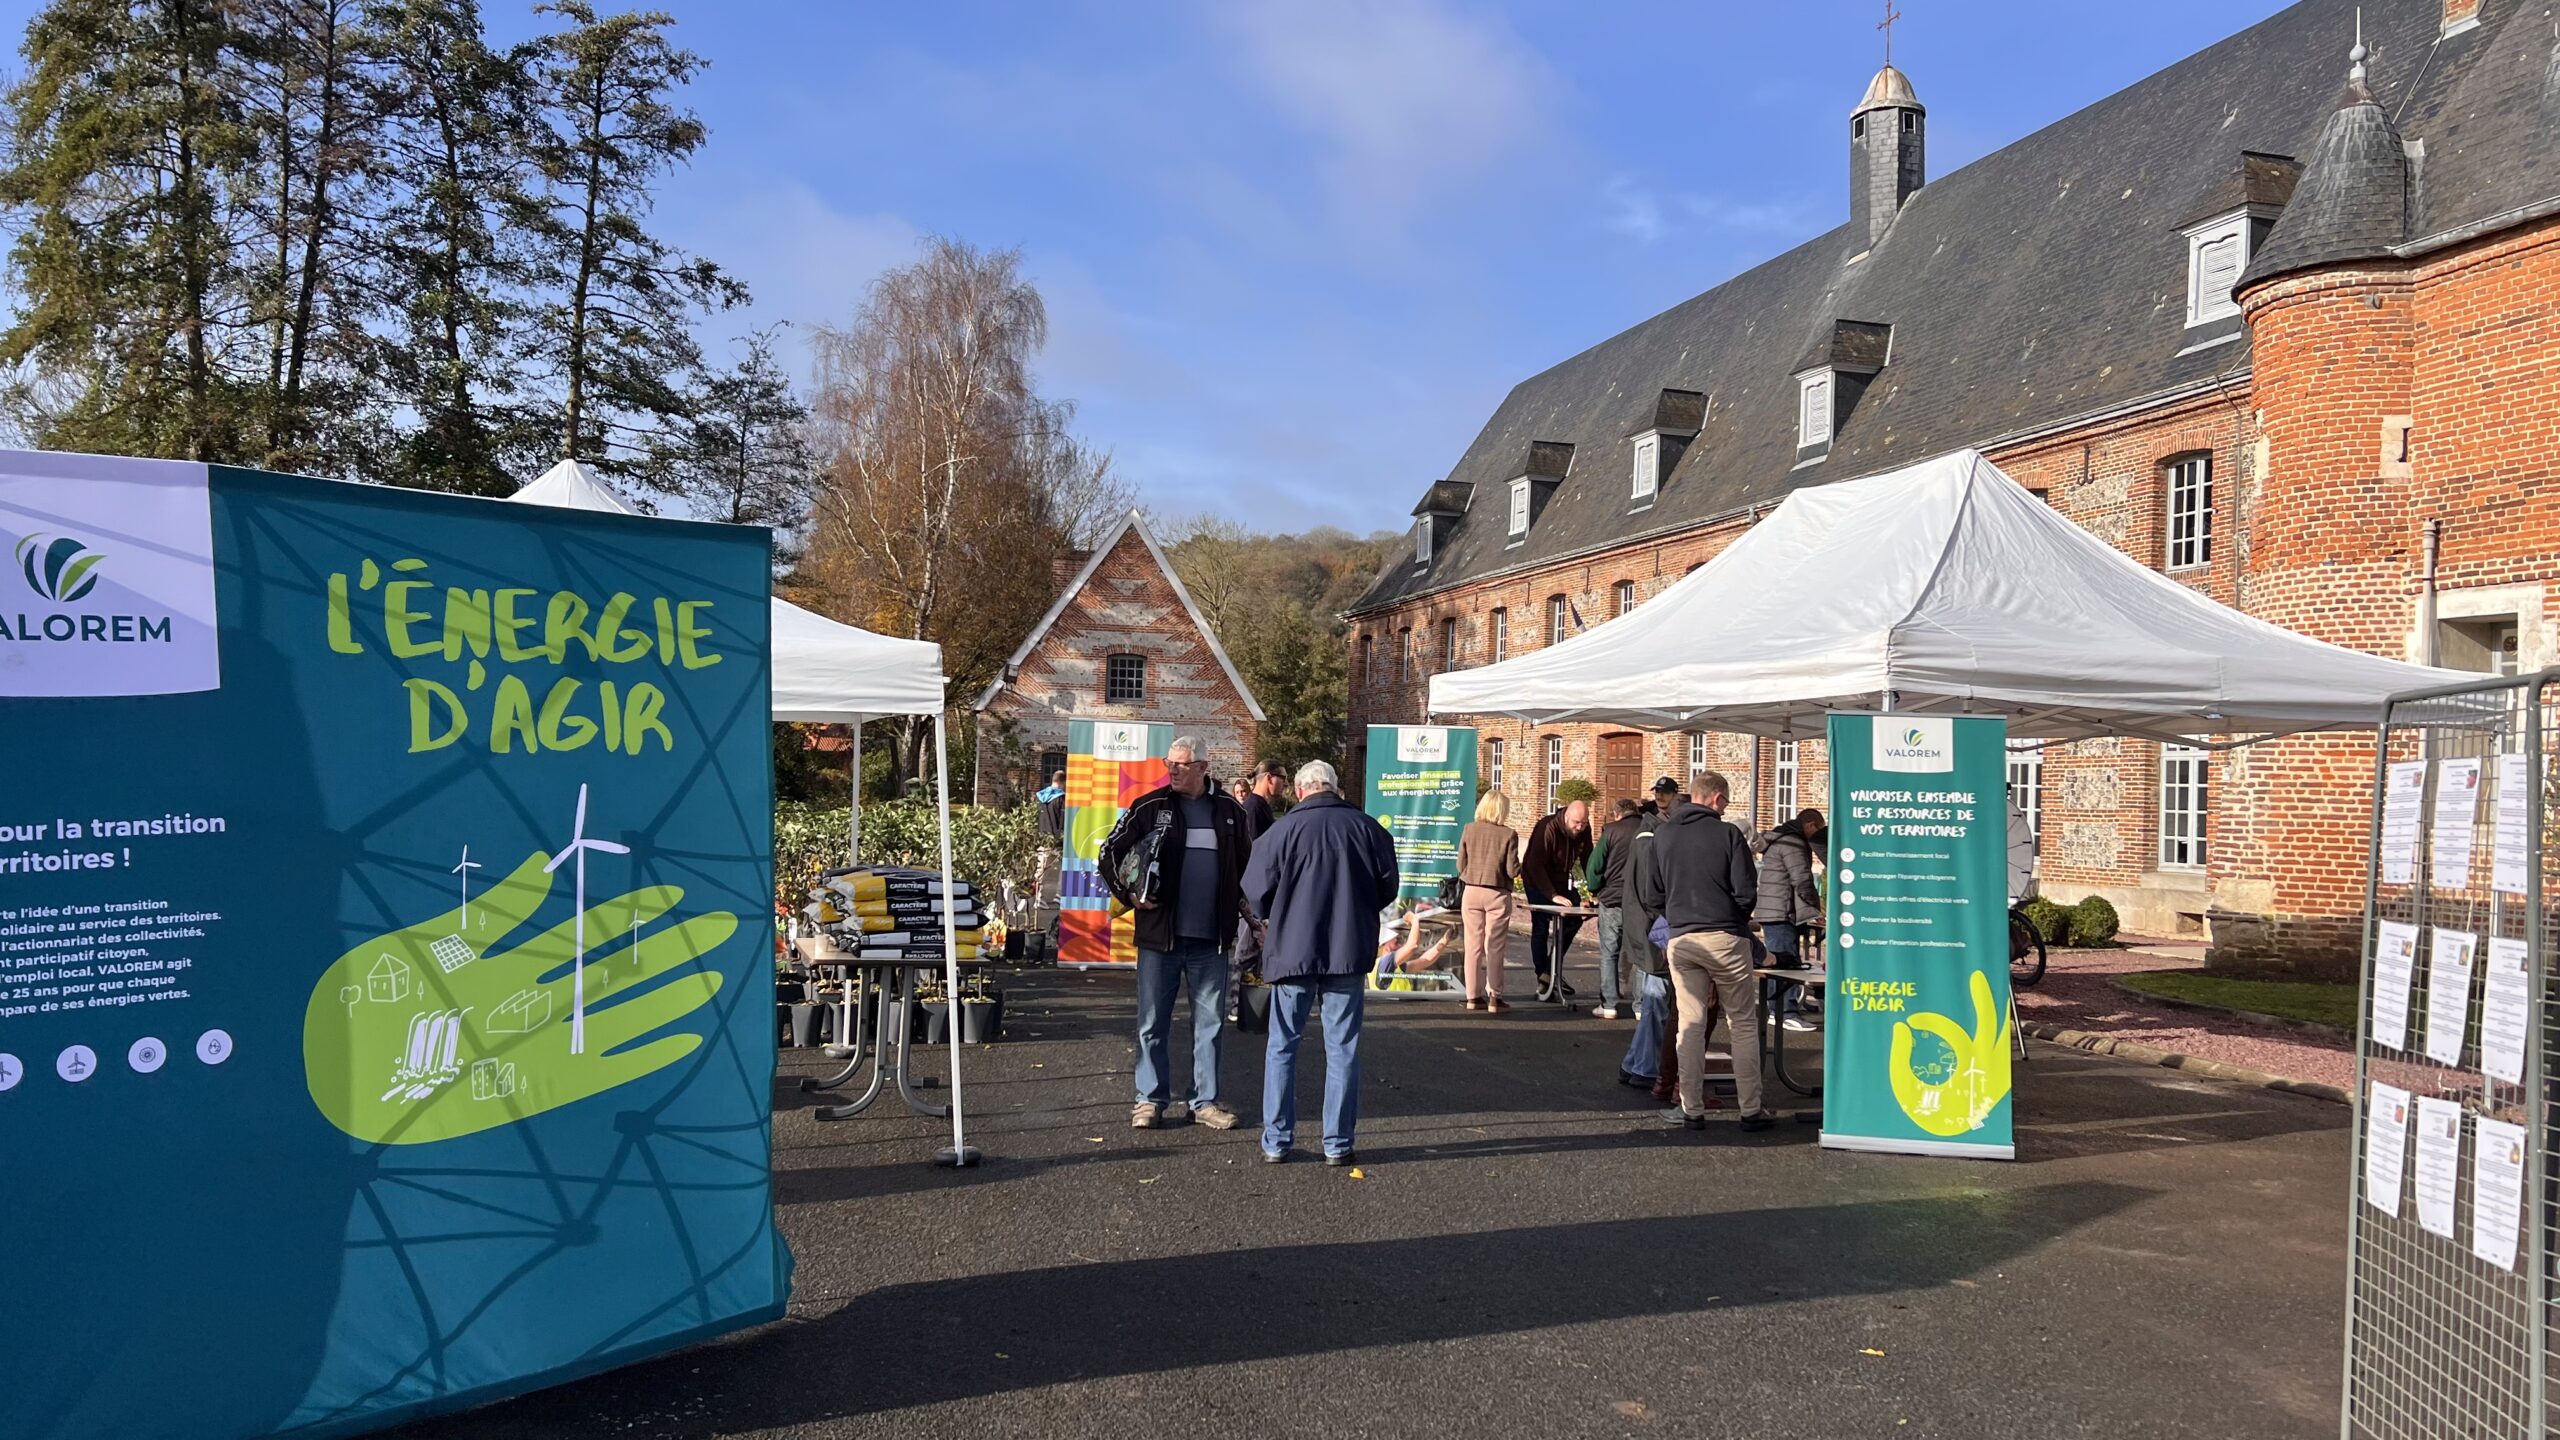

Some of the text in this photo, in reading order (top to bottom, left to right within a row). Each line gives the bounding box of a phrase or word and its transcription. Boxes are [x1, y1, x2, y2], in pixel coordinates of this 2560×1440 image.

[403, 659, 673, 755] D'AGIR
[1886, 748, 1940, 758] VALOREM
[1382, 772, 1418, 780] Favoriser
[1441, 779, 1464, 788] grâce
[1399, 788, 1434, 797] énergies
[1850, 790, 1976, 804] VALORISER ENSEMBLE
[1852, 806, 1975, 821] LES RESSOURCES DE
[57, 819, 82, 839] la
[91, 813, 226, 837] transition
[1860, 824, 1967, 838] VOS TERRITOIRES
[21, 906, 58, 919] l'idée
[62, 904, 100, 915] d'une
[104, 899, 168, 913] transition
[2, 910, 222, 936] olidaire au service des territoires.
[1, 926, 205, 952] l'actionnariat des collectivités,
[16, 950, 95, 969] participatif
[97, 947, 149, 961] citoyen,
[58, 966, 94, 980] local,
[98, 960, 163, 976] VALOREM
[167, 957, 192, 972] agit
[12, 988, 30, 999] 25
[33, 987, 59, 997] ans
[63, 983, 95, 998] pour
[98, 979, 124, 993] que
[127, 974, 176, 990] chaque
[40, 1000, 58, 1012] de
[62, 999, 85, 1010] ses
[88, 991, 145, 1007] énergies
[148, 988, 190, 1002] vertes.
[1852, 995, 1905, 1012] D'AGIR
